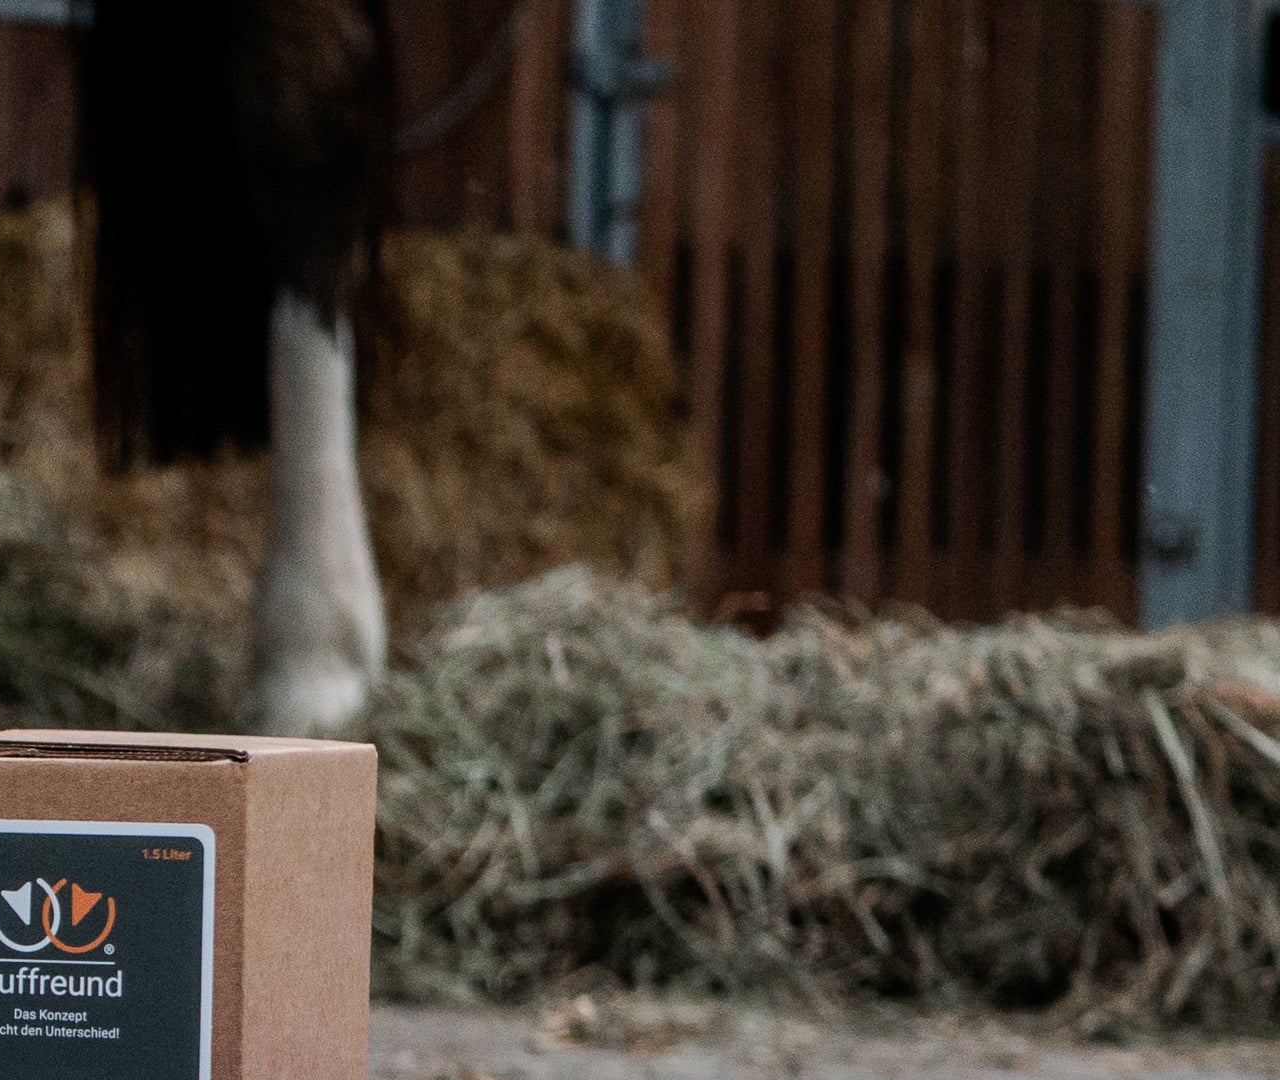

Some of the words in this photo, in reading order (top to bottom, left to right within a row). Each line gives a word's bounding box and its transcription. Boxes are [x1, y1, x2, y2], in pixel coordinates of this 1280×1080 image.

[142, 848, 161, 860] 1.5
[162, 849, 192, 861] Liter
[13, 1008, 37, 1021] Das
[39, 1009, 88, 1024] Konzept
[20, 1024, 43, 1037] den
[45, 1025, 120, 1039] Unterschied!
